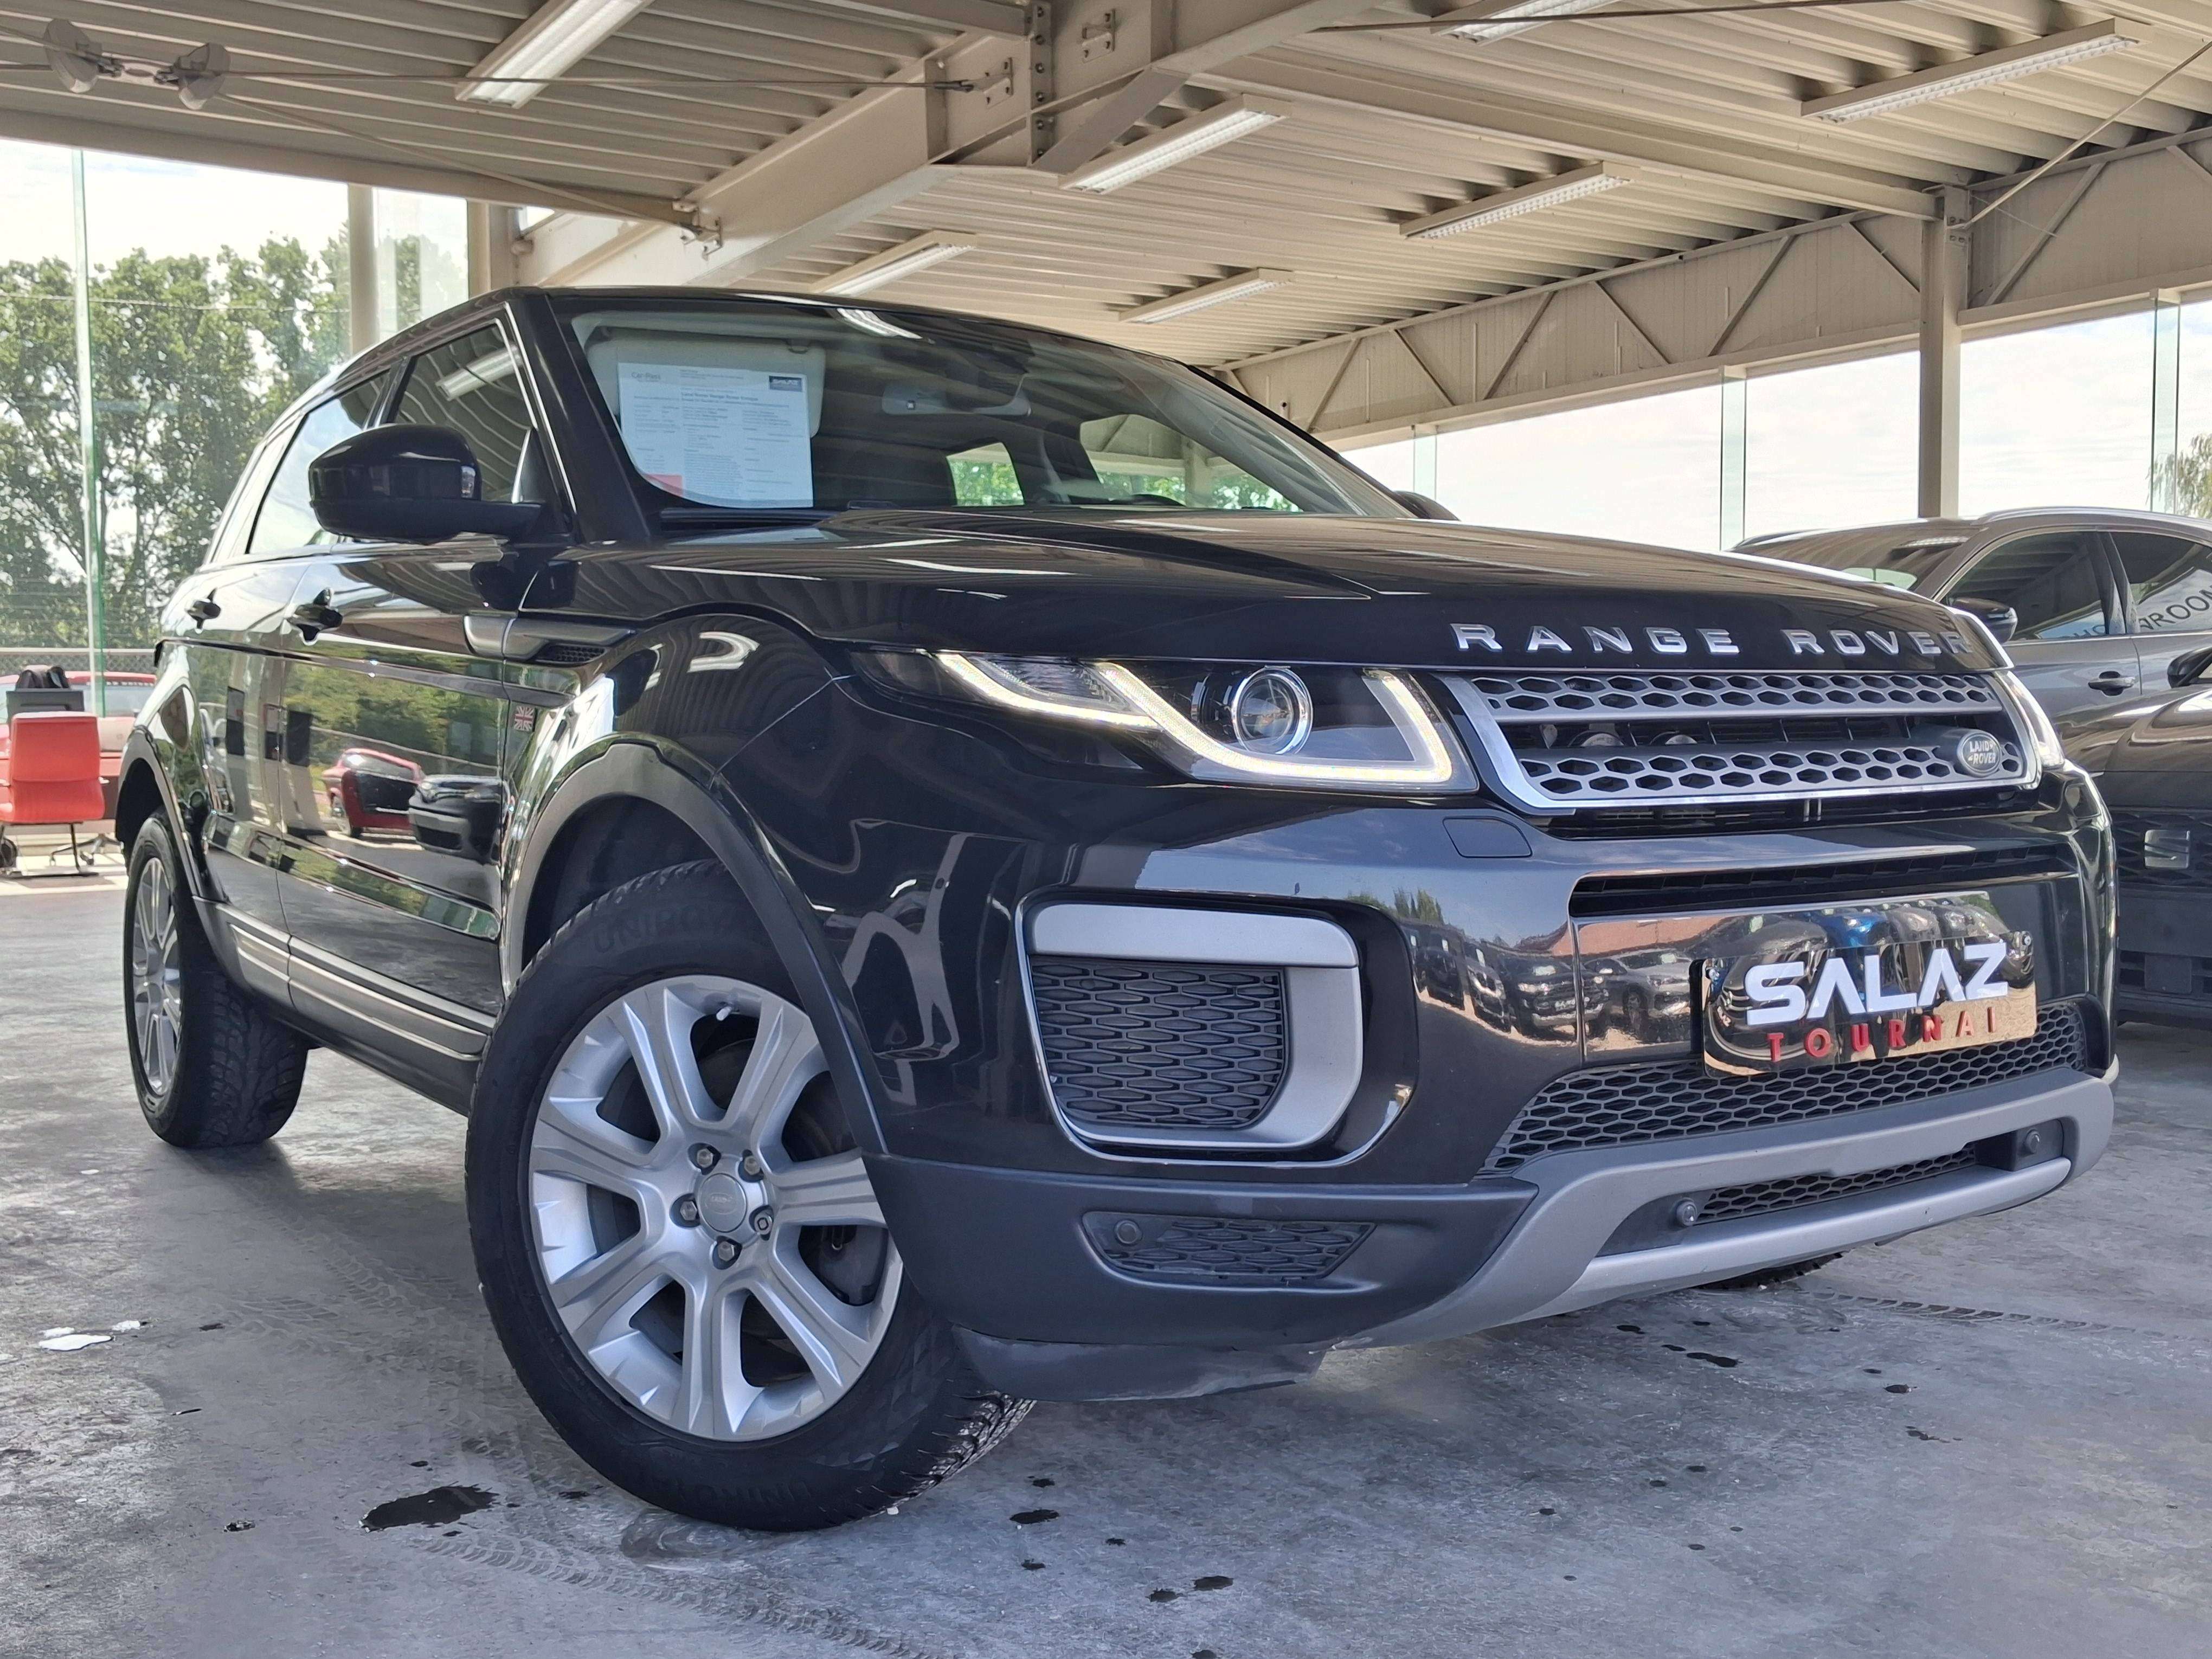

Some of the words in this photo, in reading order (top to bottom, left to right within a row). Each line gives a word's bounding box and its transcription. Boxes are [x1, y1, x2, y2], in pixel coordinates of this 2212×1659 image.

[1450, 623, 1739, 654] RANGE
[1779, 629, 1973, 655] ROVER
[1969, 741, 1989, 753] LAND
[1973, 753, 1996, 764] ROVER
[1745, 943, 2008, 1025] SALAZ
[1767, 1007, 1996, 1063] TOURNAI
